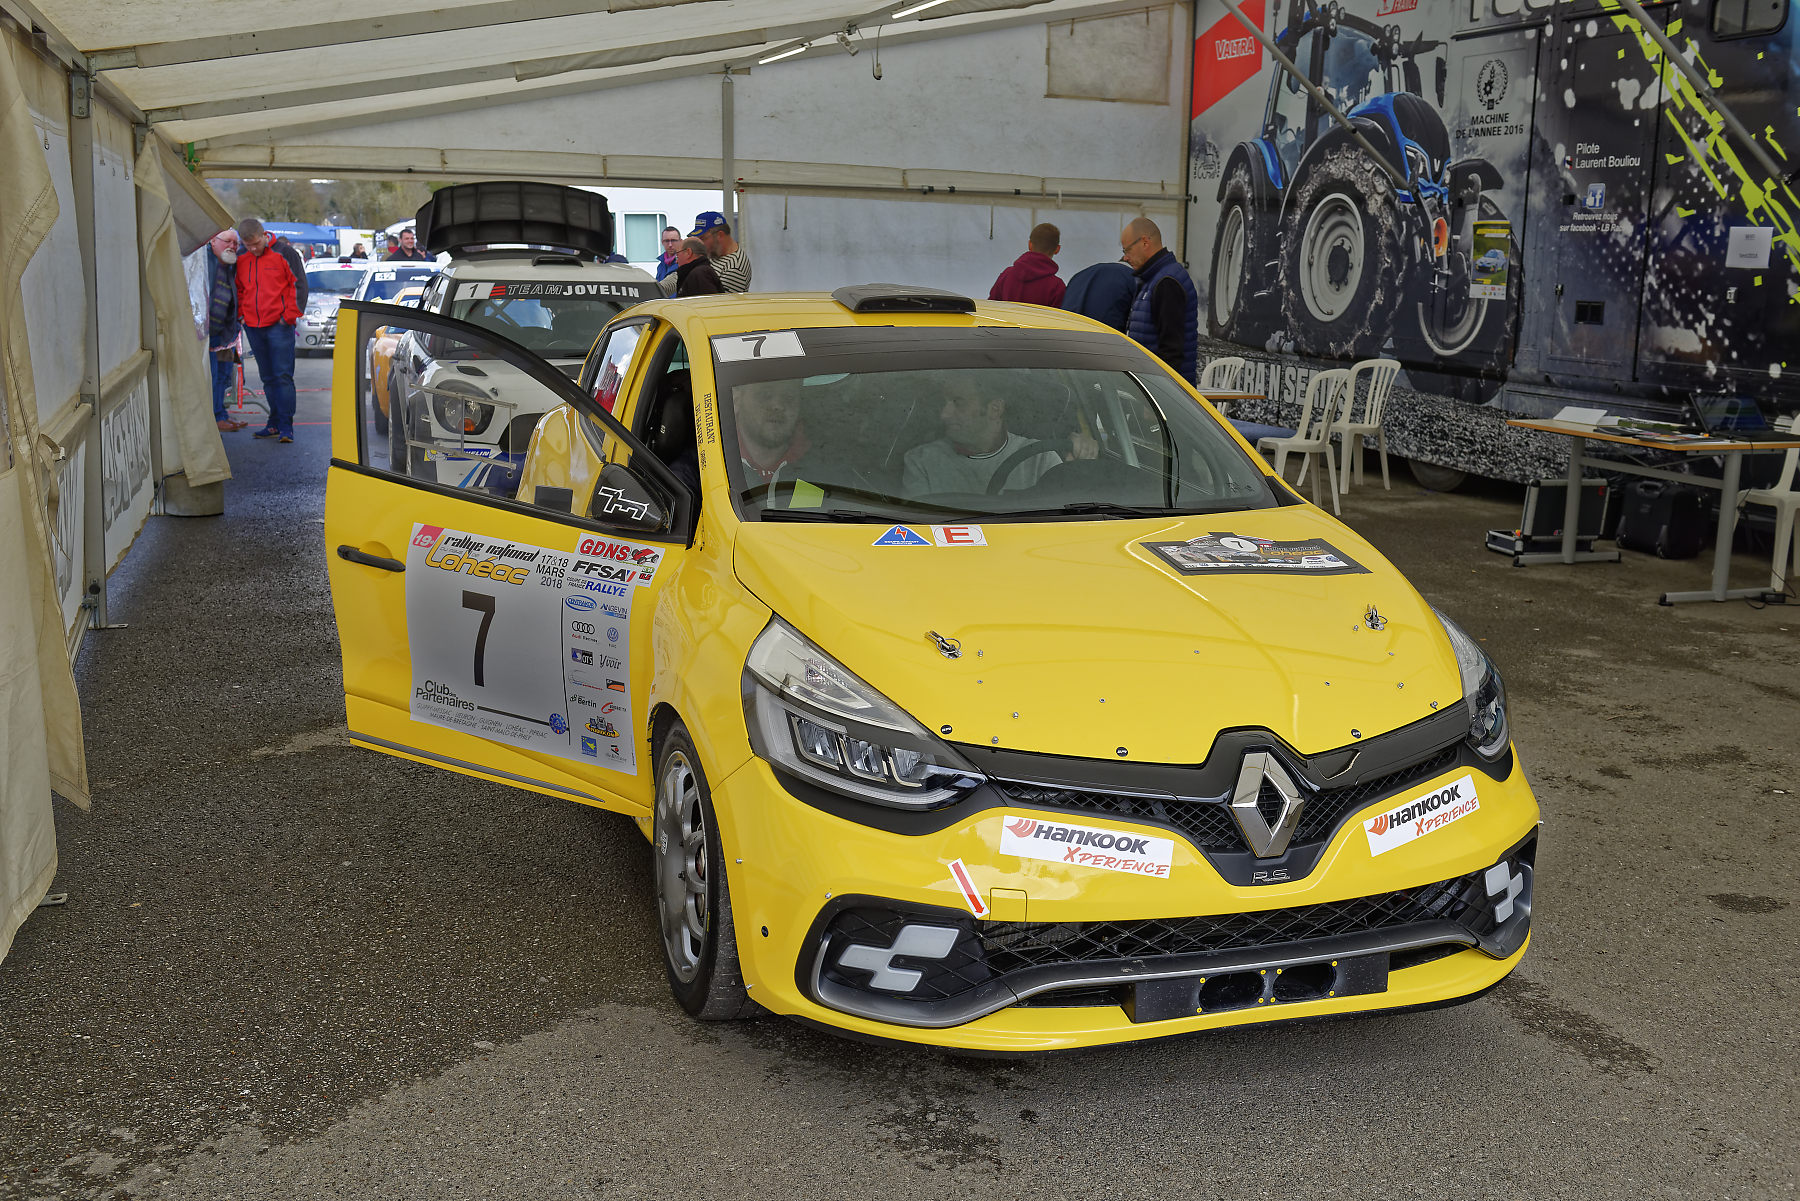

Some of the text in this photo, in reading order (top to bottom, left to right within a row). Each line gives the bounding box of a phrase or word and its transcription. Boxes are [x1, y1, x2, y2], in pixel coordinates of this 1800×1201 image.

[1215, 36, 1256, 61] VALTRA
[1470, 112, 1510, 126] MACHINE
[1455, 124, 1525, 140] DE L'ANNEE 2016
[1576, 143, 1600, 155] Pilote
[1575, 154, 1641, 169] Laurent Bouliou
[1572, 211, 1602, 221] Retrouvez
[1570, 223, 1597, 232] facebook
[468, 283, 640, 299] 1 TEAM JOVELIN
[741, 335, 767, 358] 7
[703, 392, 716, 445] RESTAURANT
[943, 527, 975, 544] E
[443, 534, 485, 554] rallye
[485, 543, 541, 562] national
[579, 539, 631, 561] GDNS
[1230, 540, 1244, 549] 7
[535, 563, 566, 579] MARS
[571, 560, 627, 582] FFSA
[540, 576, 563, 589] 2018
[585, 580, 627, 597] RALLYE
[461, 589, 497, 688] 7
[424, 679, 450, 696] Club
[415, 687, 475, 711] Partenaires
[577, 697, 597, 708] Bertin
[1415, 796, 1478, 837] XPERIENCE
[1063, 846, 1169, 876] XPERIENCE
